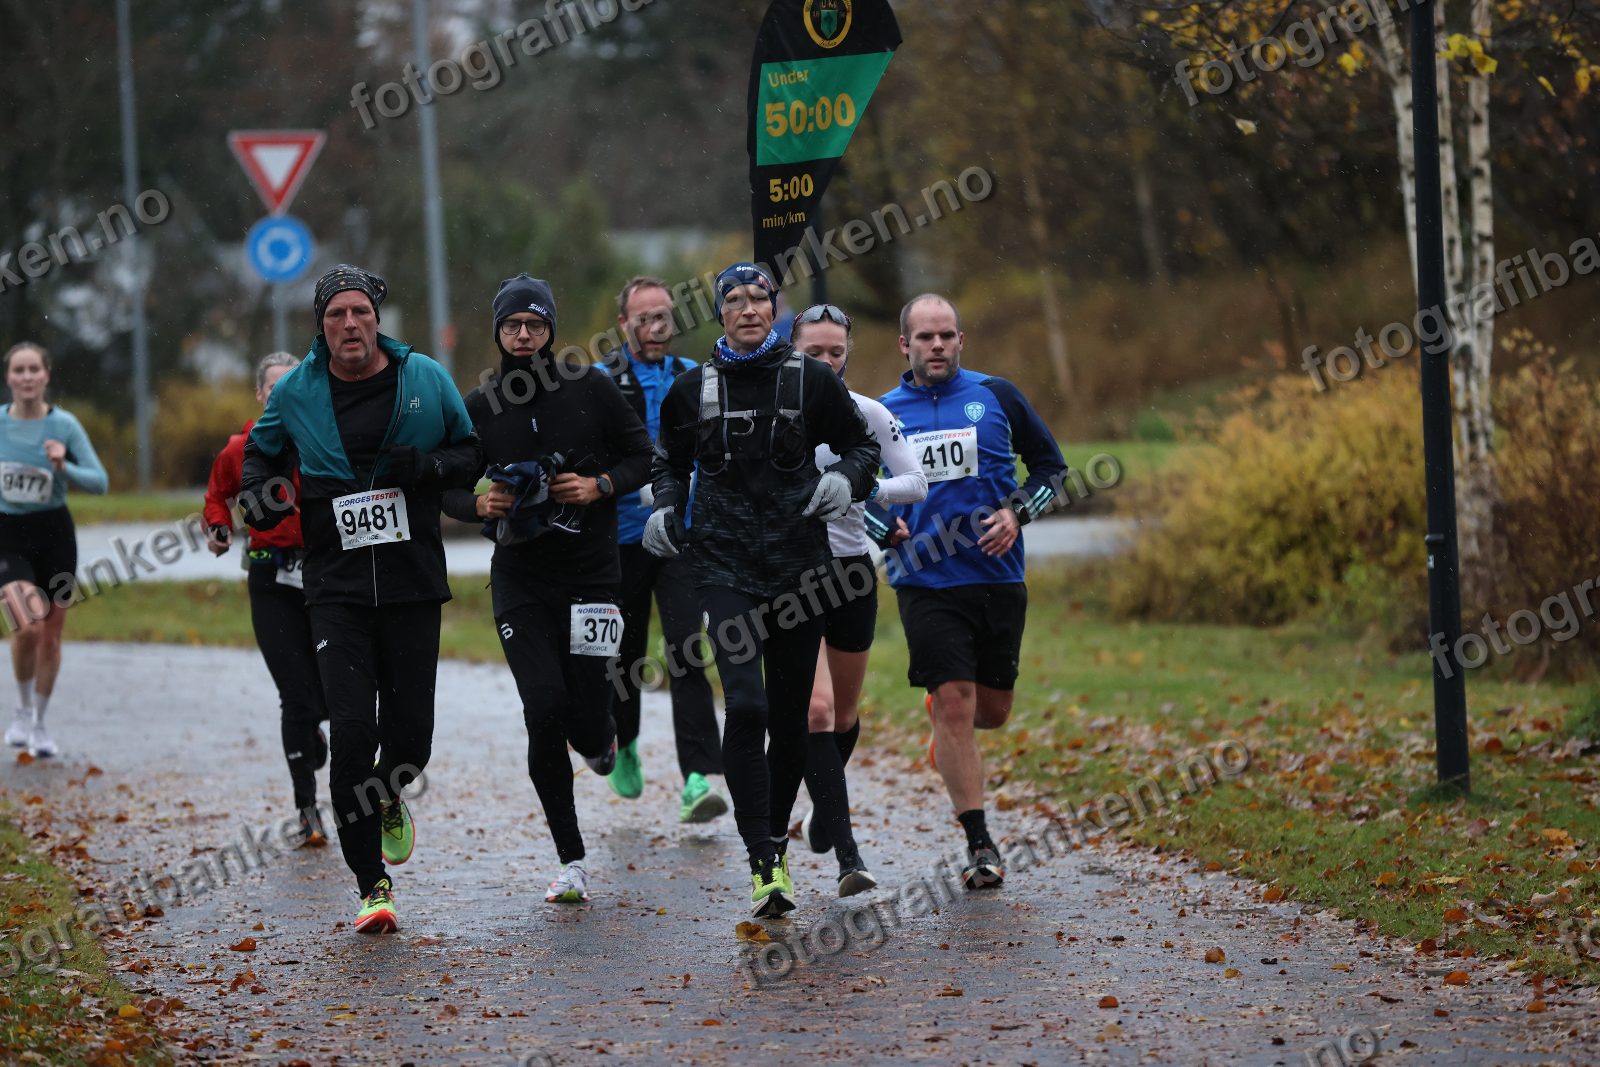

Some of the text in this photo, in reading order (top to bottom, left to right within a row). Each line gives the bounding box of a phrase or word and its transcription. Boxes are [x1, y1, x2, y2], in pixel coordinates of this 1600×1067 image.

[768, 69, 809, 88] Under
[765, 93, 856, 137] 50:00
[769, 173, 814, 203] 5:00
[762, 211, 806, 229] min/km
[528, 303, 548, 316] Swix
[913, 431, 972, 444] NORGESTESTEN
[922, 441, 964, 469] 410
[3, 473, 48, 492] 9477
[341, 502, 399, 536] 9481
[584, 617, 618, 644] 370
